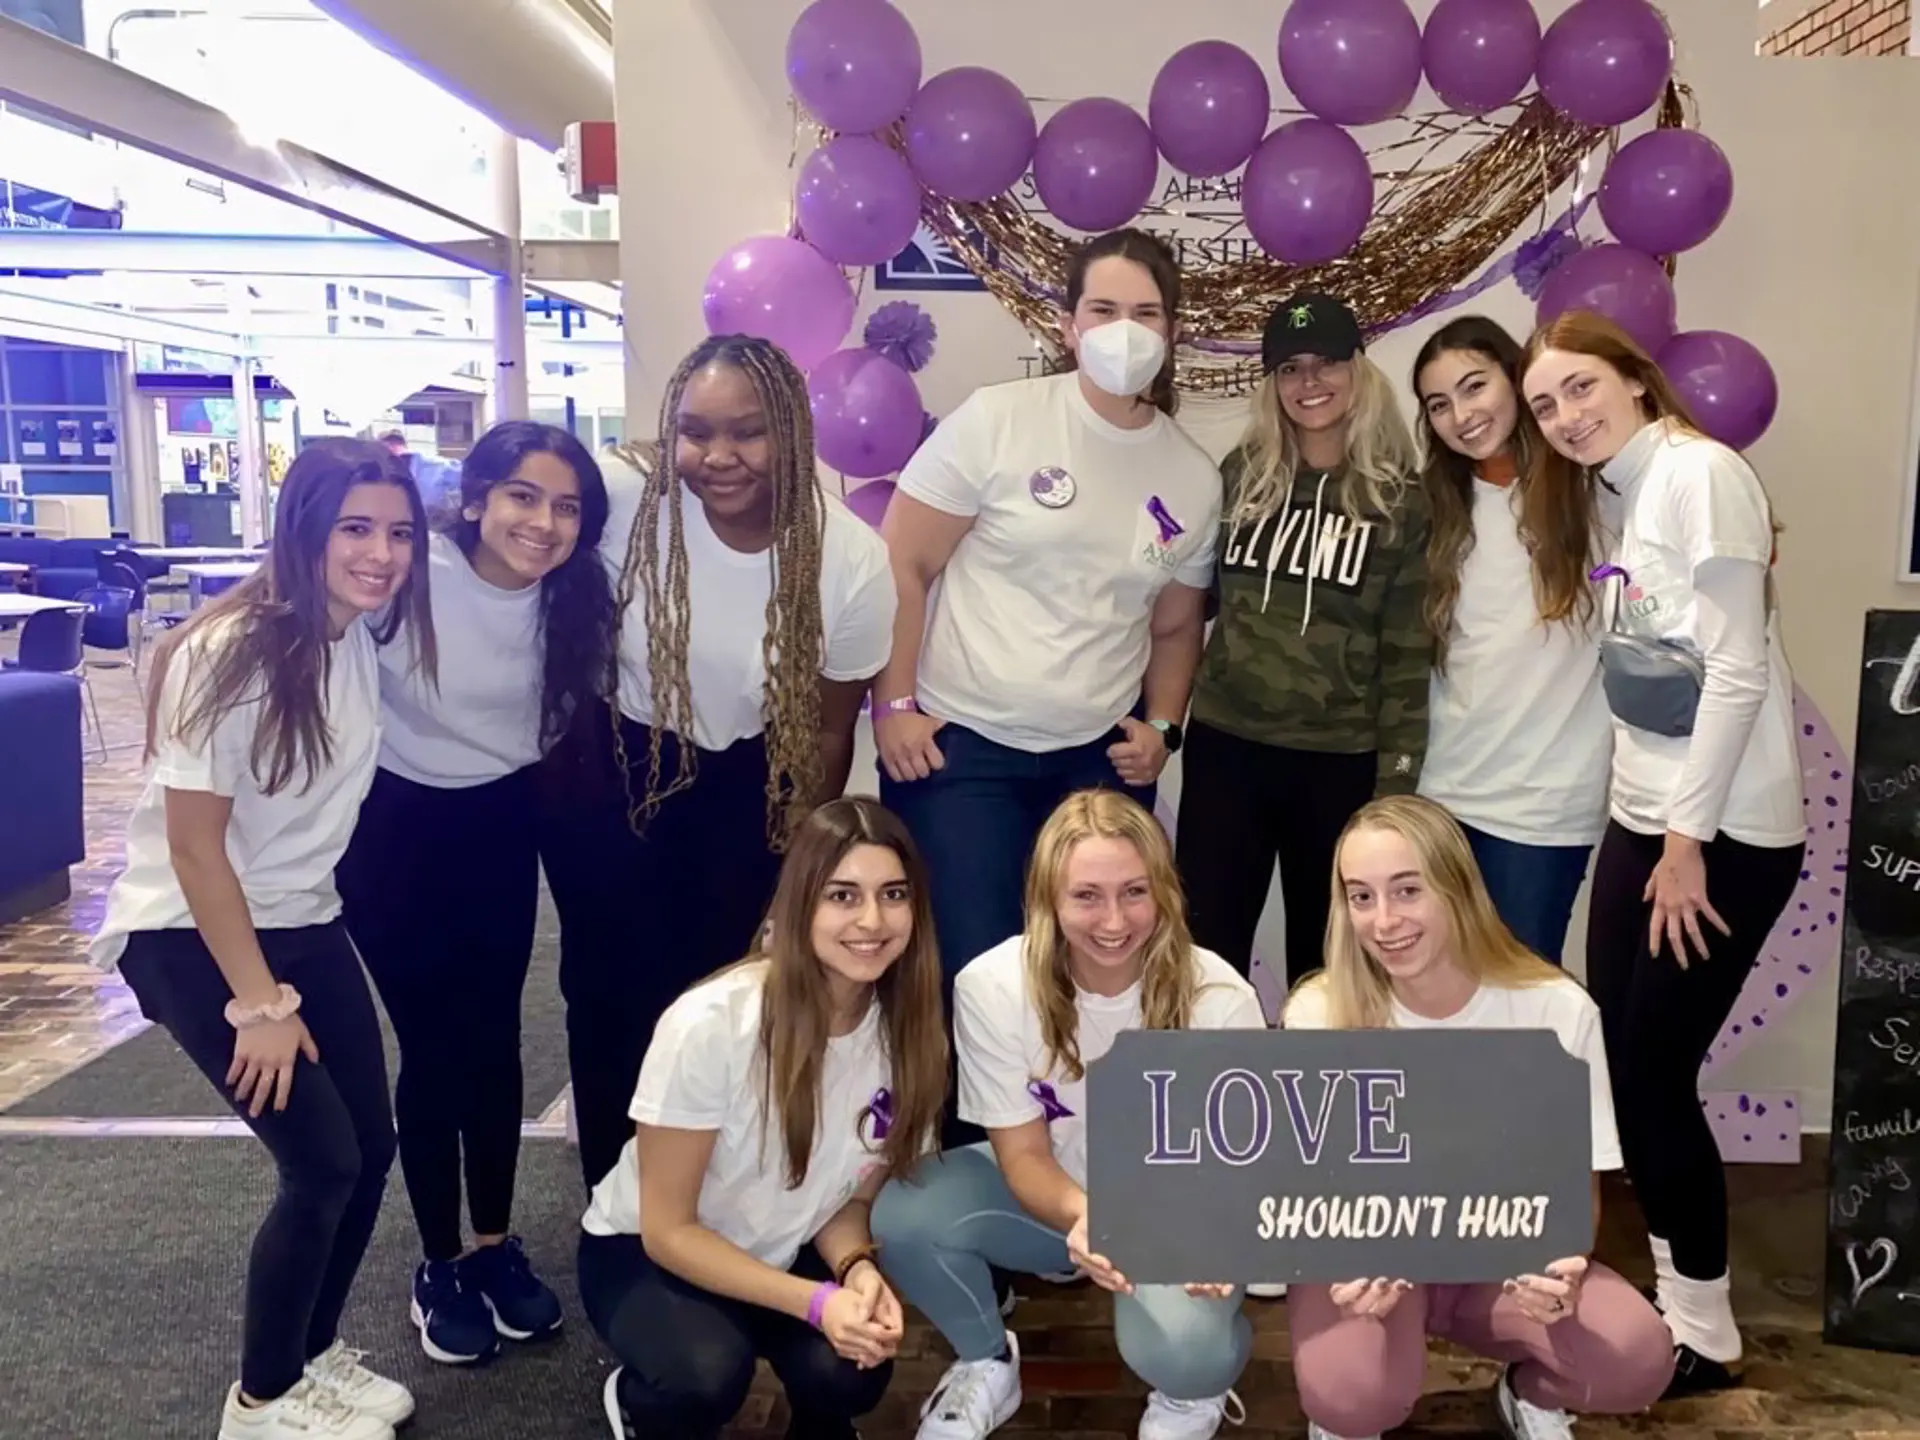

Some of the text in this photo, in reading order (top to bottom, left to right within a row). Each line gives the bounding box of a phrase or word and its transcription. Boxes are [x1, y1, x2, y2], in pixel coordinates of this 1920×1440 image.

[1143, 1068, 1411, 1166] LOVE
[1257, 1195, 1550, 1241] SHOULDN'T HURT
